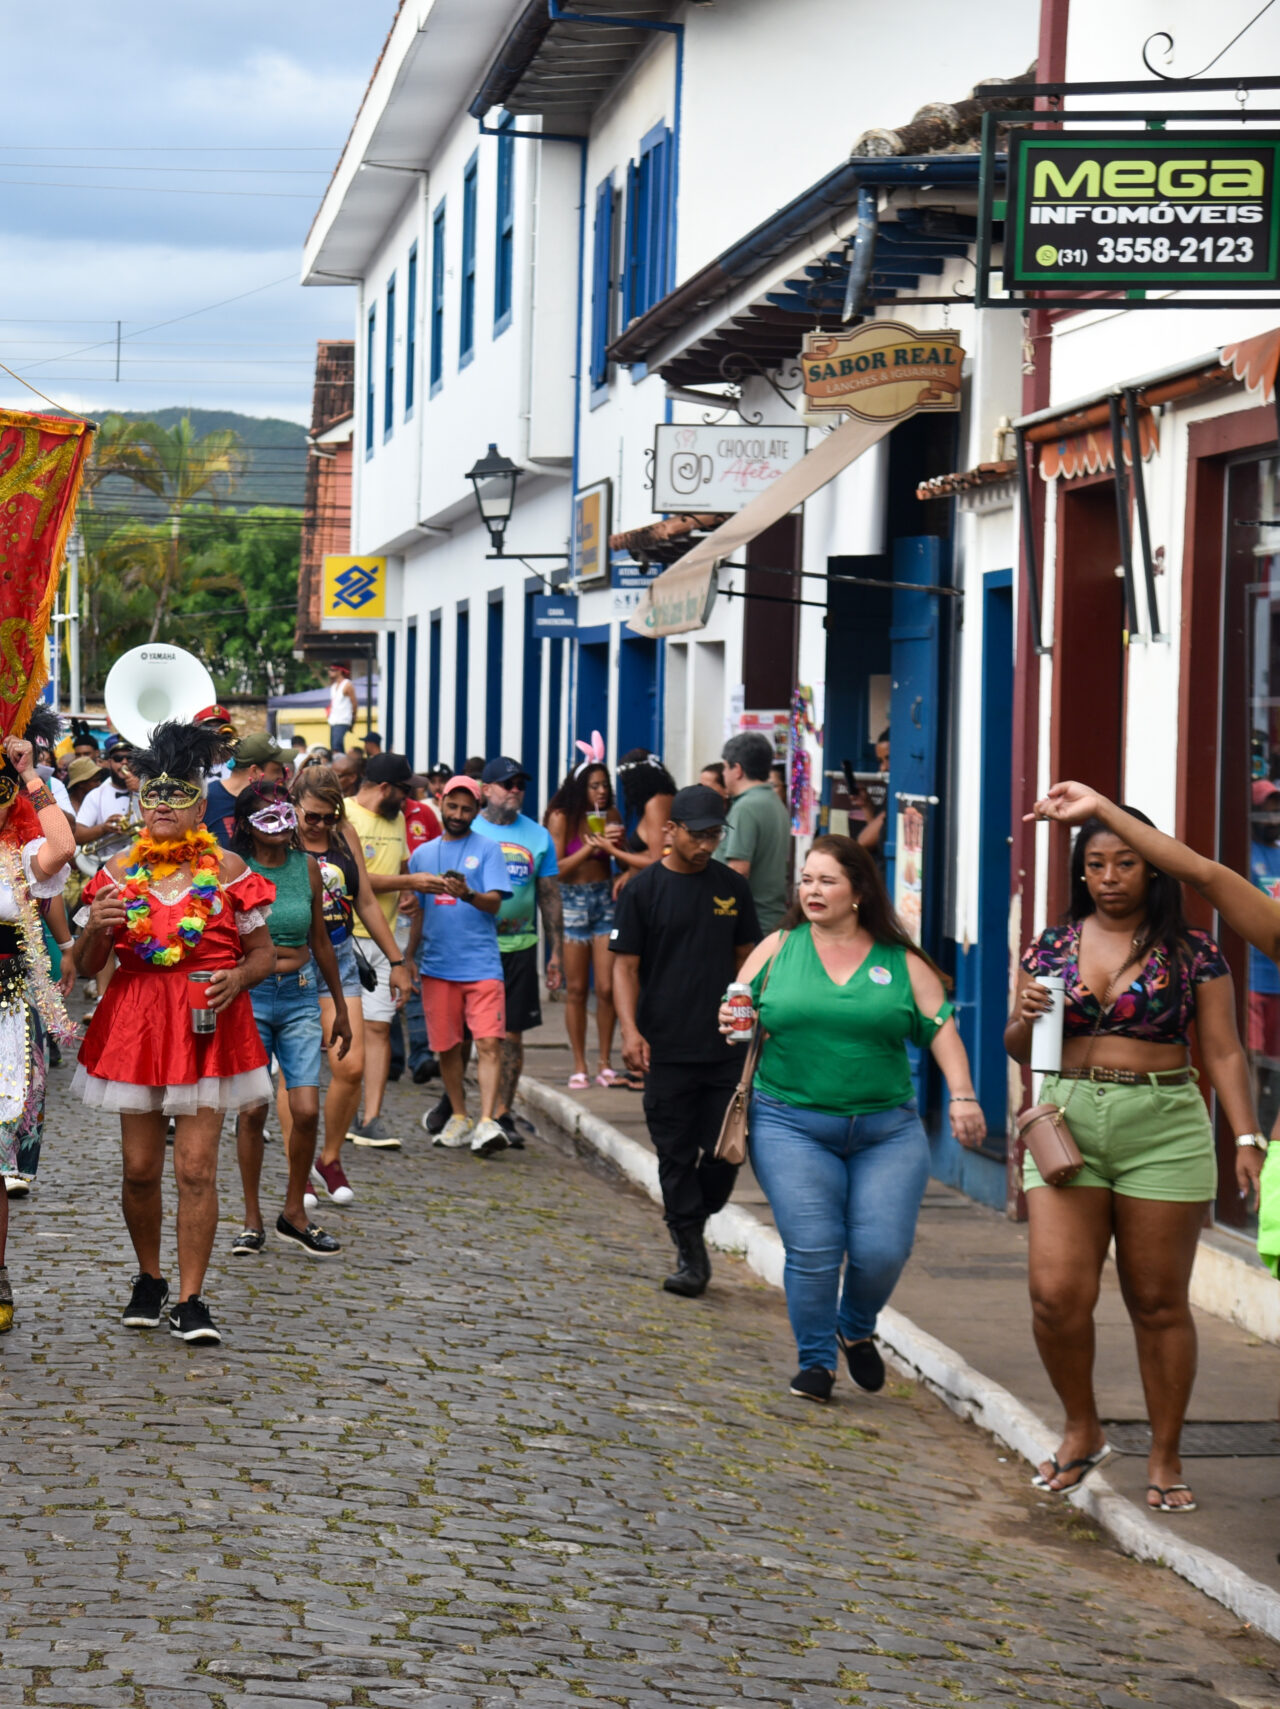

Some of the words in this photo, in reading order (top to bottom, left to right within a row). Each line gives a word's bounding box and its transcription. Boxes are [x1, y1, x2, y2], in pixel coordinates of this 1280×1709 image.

[1029, 201, 1264, 225] INFOMÓVEIS
[1057, 249, 1089, 267] (31)
[1096, 236, 1255, 264] 3558-2123
[808, 351, 888, 383] SABOR
[893, 347, 957, 367] REAL
[826, 375, 879, 394] LANCHES
[880, 372, 889, 381] &
[891, 367, 947, 379] IGUARIAS
[718, 439, 789, 460] CHOCOLATE
[720, 458, 783, 488] Afeto
